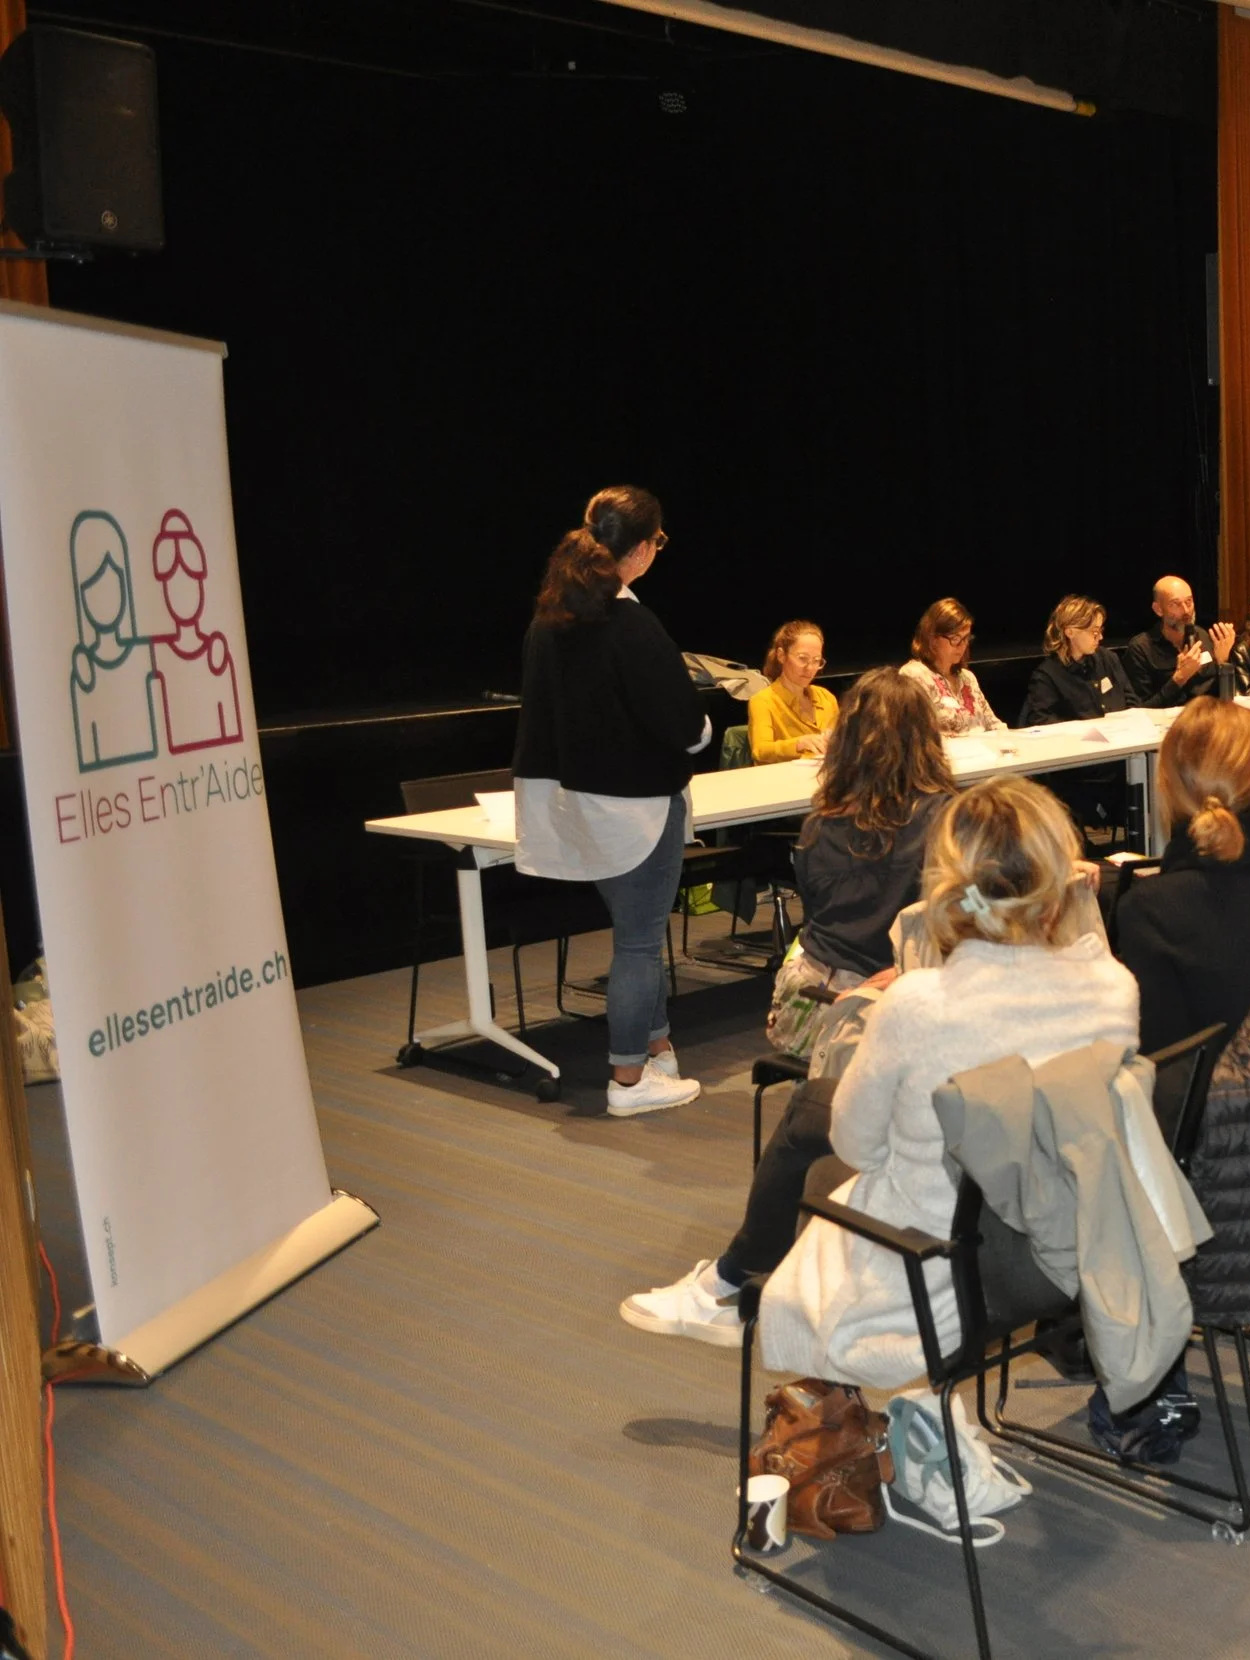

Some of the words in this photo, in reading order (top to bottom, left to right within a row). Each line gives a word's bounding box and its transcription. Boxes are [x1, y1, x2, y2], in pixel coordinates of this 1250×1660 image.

[55, 788, 132, 844] Elles
[138, 757, 264, 823] Entr'Aide
[88, 950, 288, 1057] ellesentraide.ch
